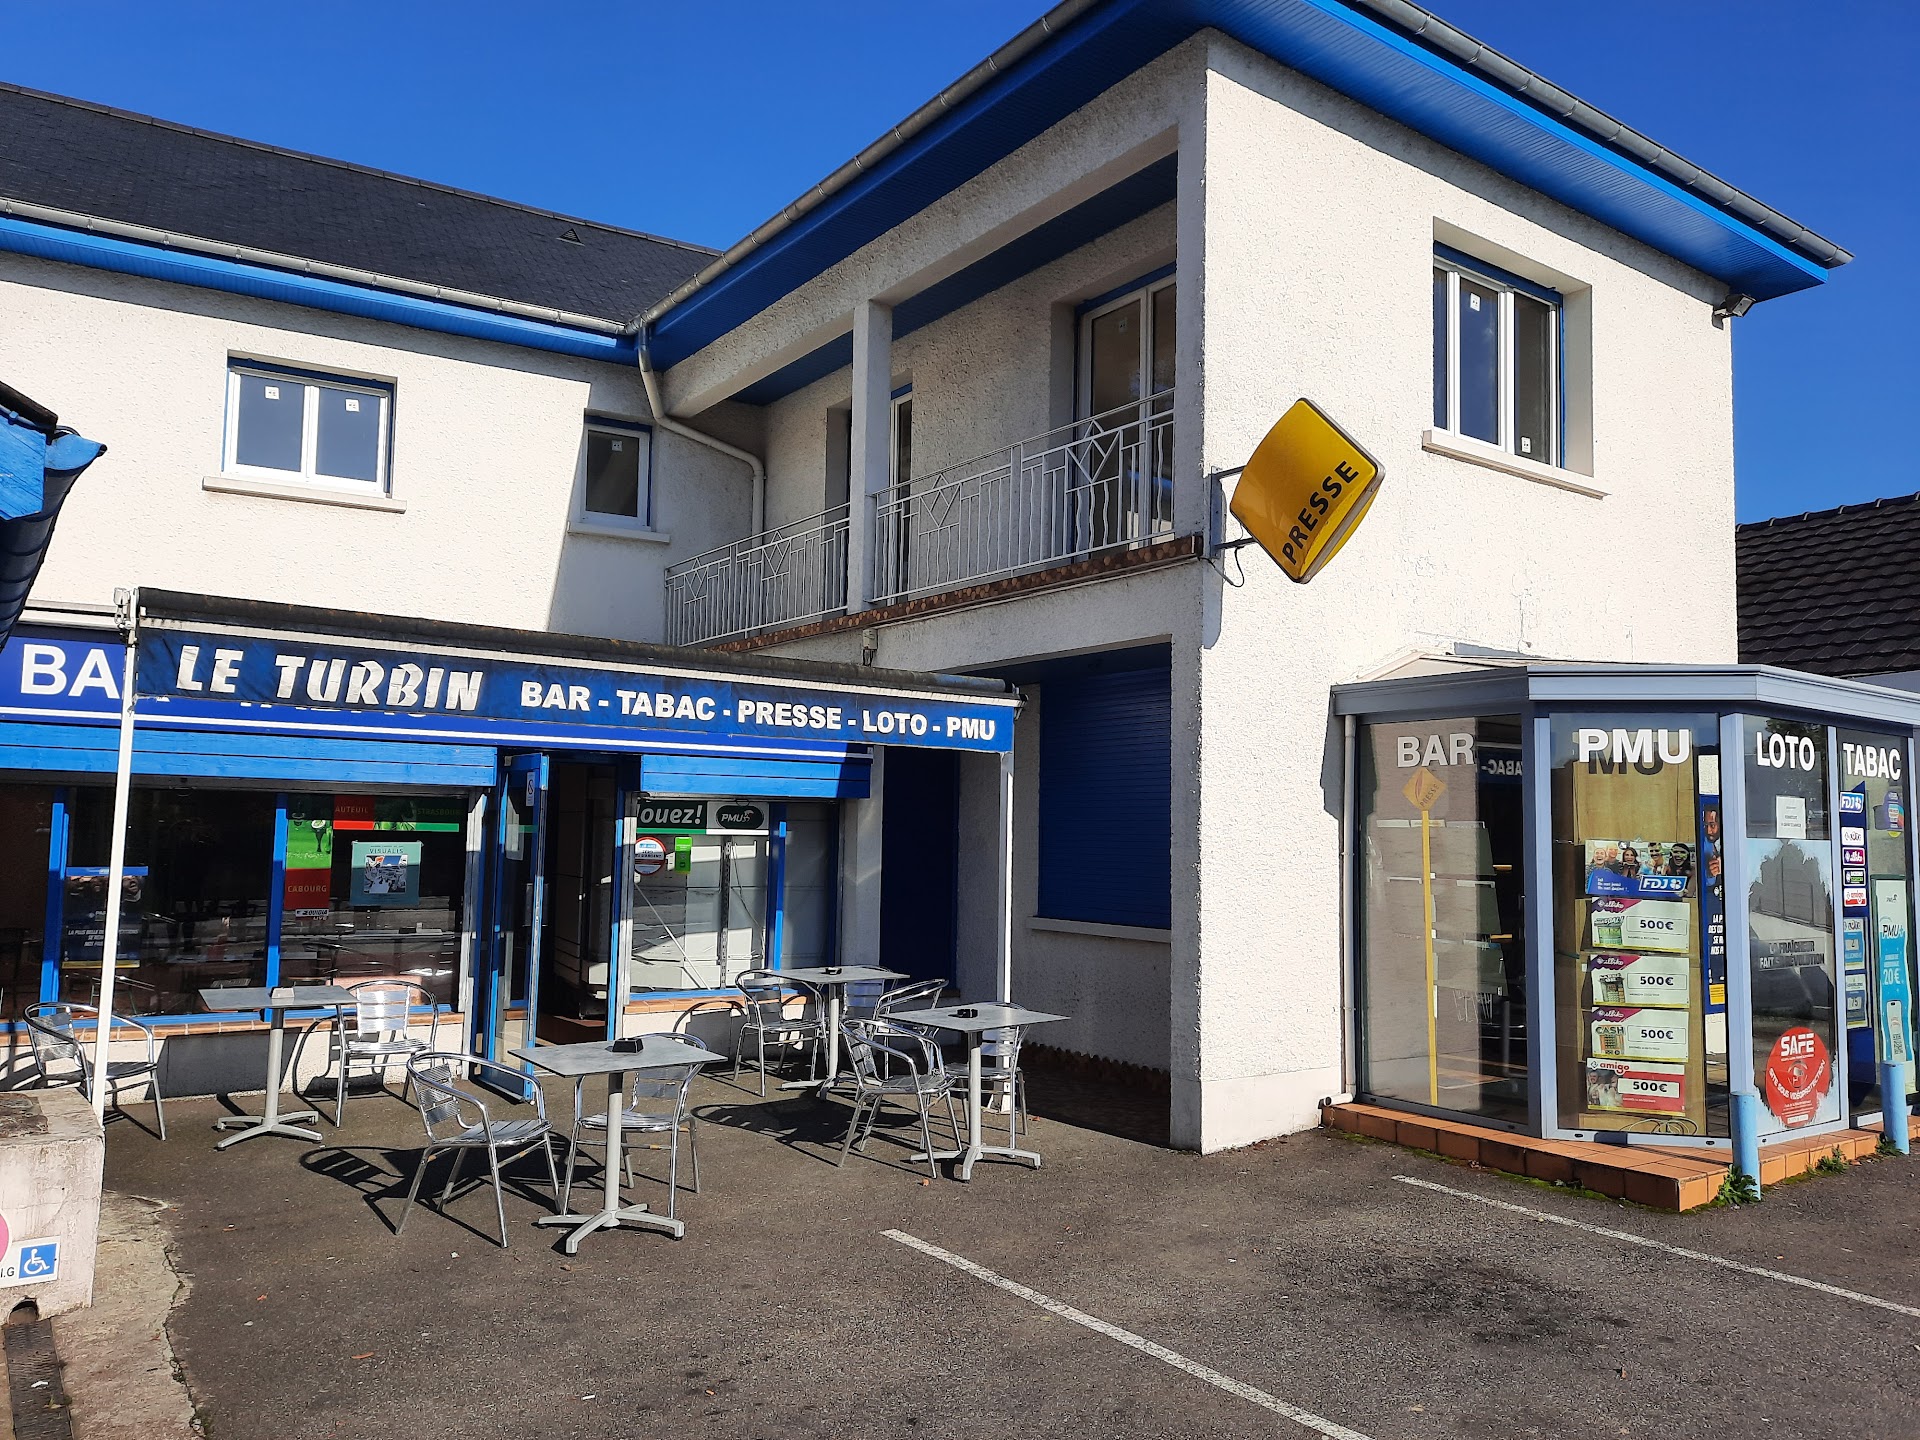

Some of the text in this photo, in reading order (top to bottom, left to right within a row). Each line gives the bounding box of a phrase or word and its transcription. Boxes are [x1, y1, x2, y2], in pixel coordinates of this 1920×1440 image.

[1281, 460, 1360, 565] PRESSE
[21, 643, 121, 700] BA
[176, 645, 244, 693] LE
[275, 654, 483, 711] TURBIN
[521, 681, 590, 711] BAR
[617, 689, 716, 721] TABAC
[737, 700, 842, 730] PRESSE
[863, 710, 927, 736] LOTO
[946, 716, 996, 740] PMU
[1397, 733, 1476, 768] BAR
[1579, 728, 1690, 764] PMU
[1756, 731, 1815, 771] LOTO
[1842, 742, 1901, 780] TABAC
[1841, 796, 1855, 808] FDJ
[335, 805, 369, 814] AUTEUIL
[721, 813, 743, 822] PMU
[287, 885, 327, 893] CABOURG
[1643, 878, 1669, 889] FDJ
[1640, 920, 1674, 930] 500€
[1759, 956, 1774, 969] FAIT
[1640, 976, 1674, 986] 500€
[1596, 1026, 1624, 1034] CASH
[1641, 1029, 1674, 1039] 500€
[1781, 1033, 1815, 1057] SAFE
[1600, 1062, 1629, 1074] amigo
[1633, 1081, 1668, 1092] 500€
[1778, 1083, 1790, 1098] SOUS
